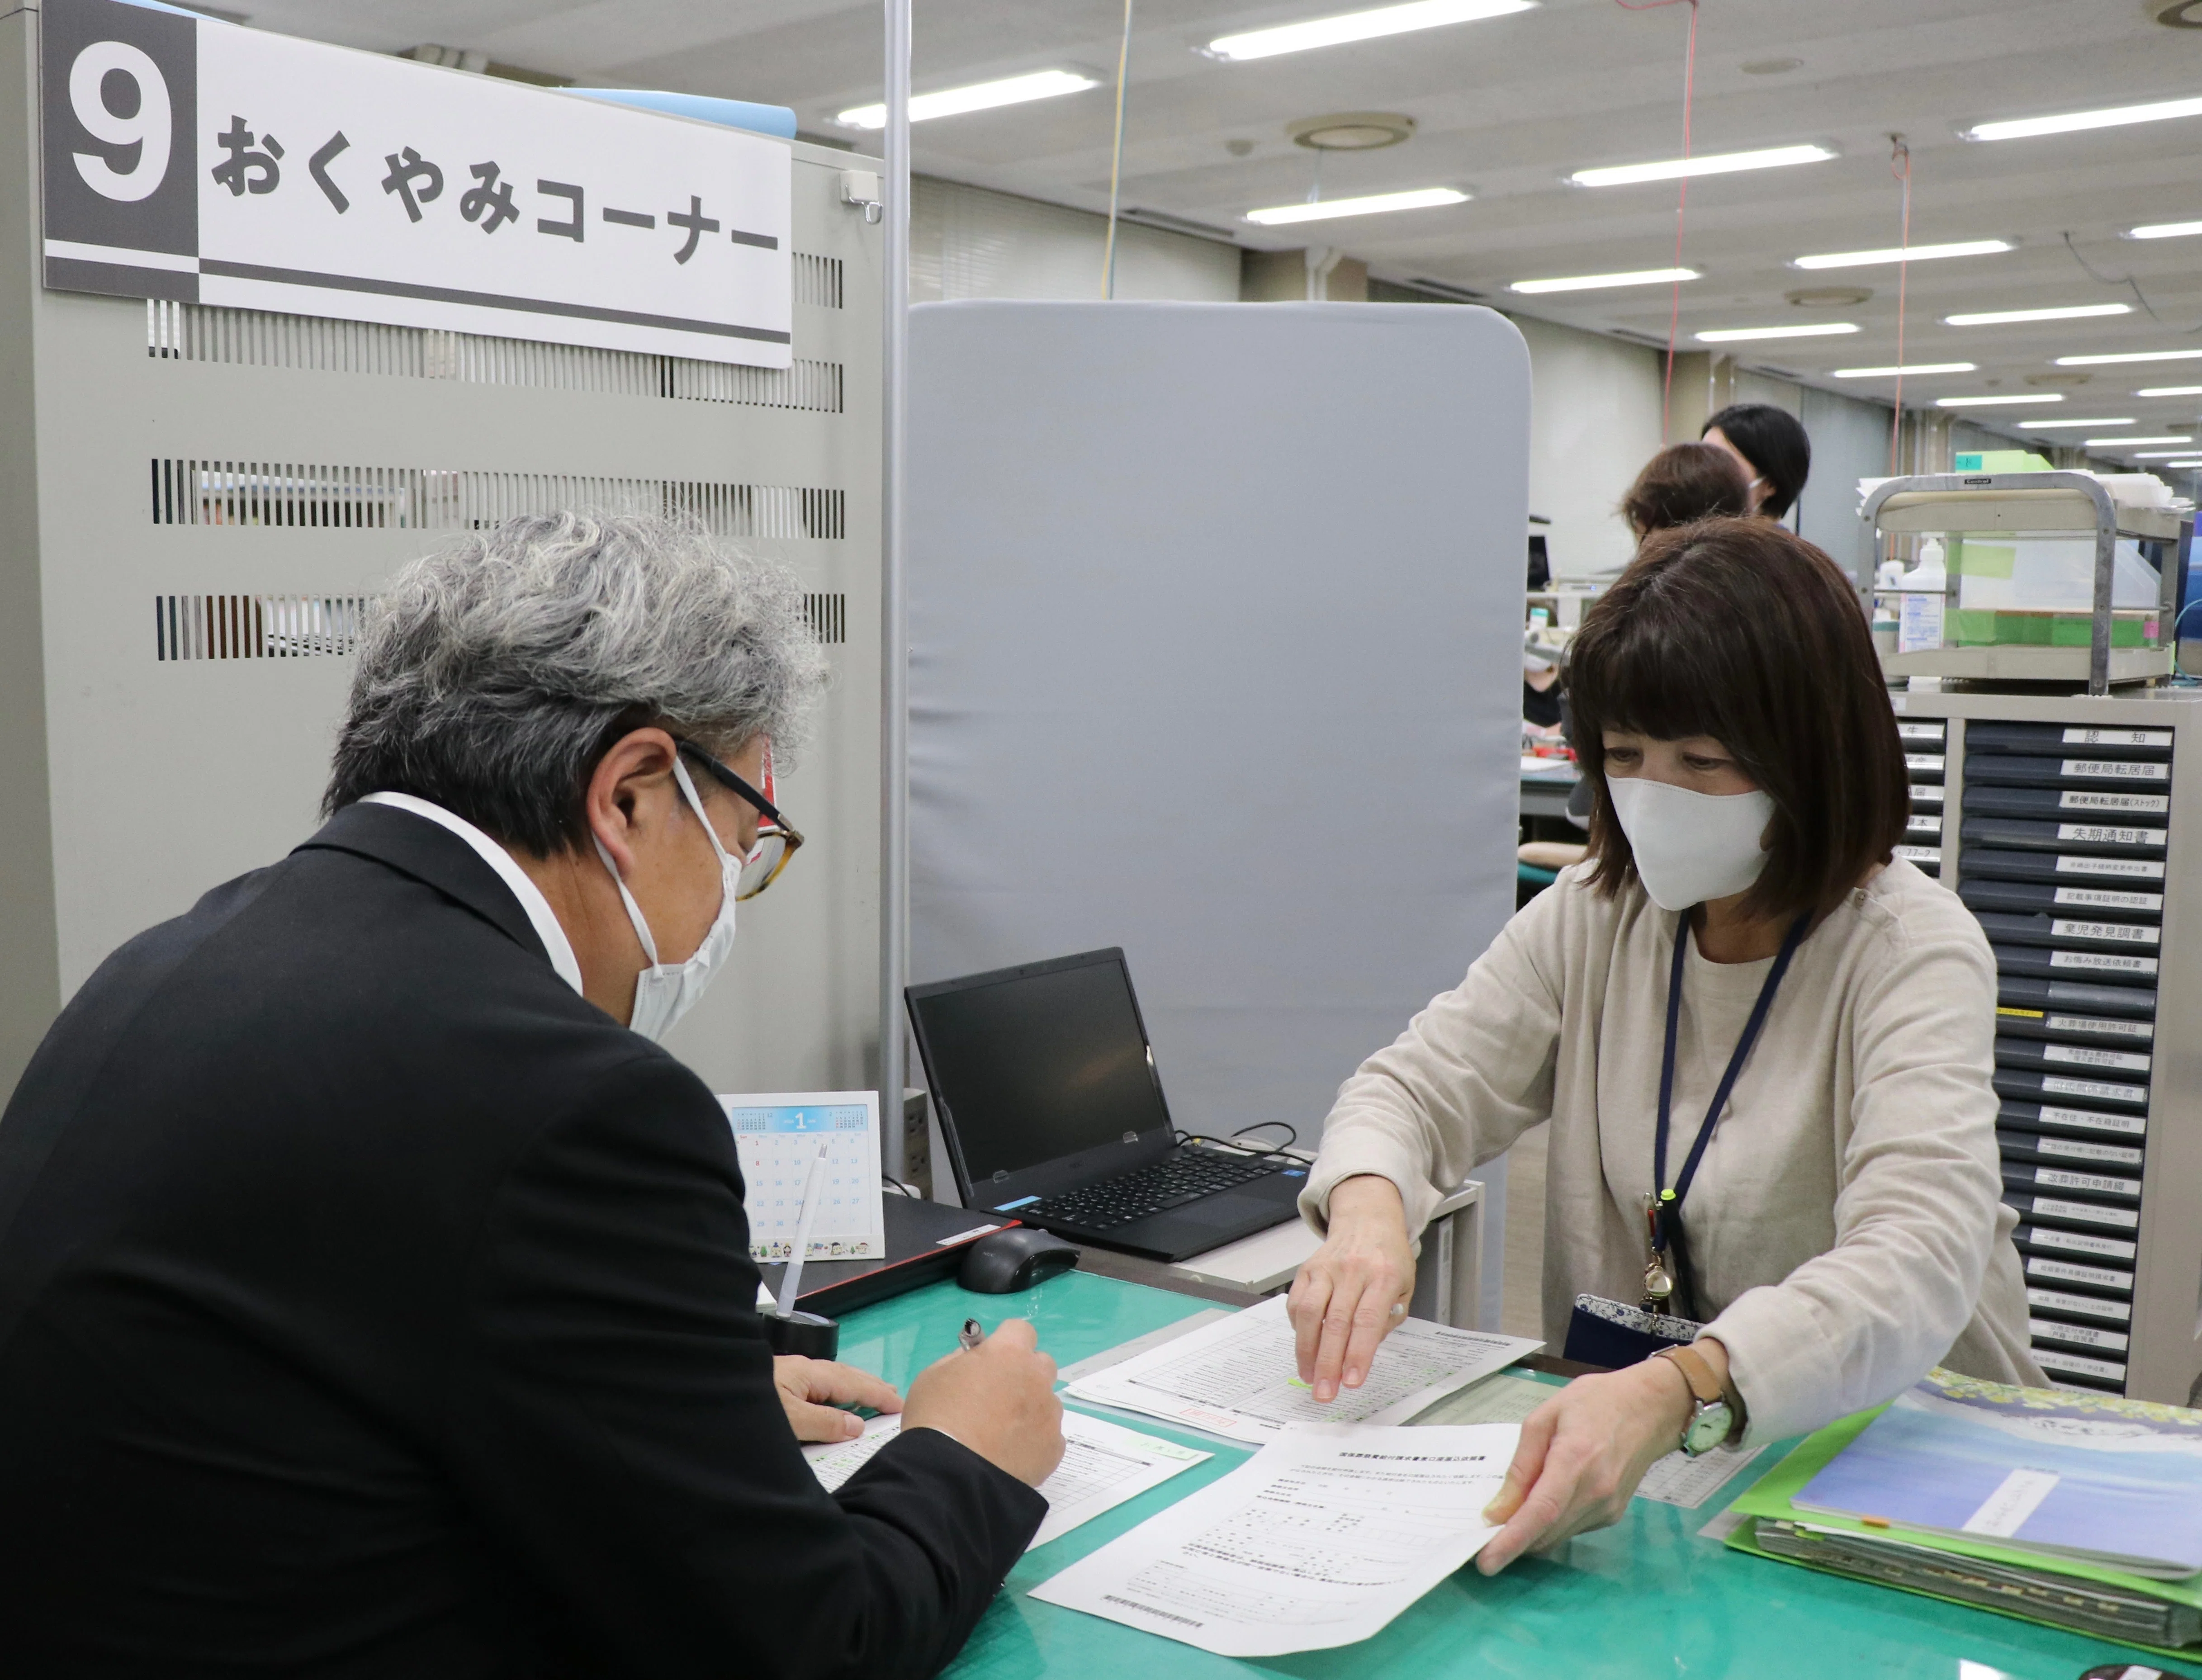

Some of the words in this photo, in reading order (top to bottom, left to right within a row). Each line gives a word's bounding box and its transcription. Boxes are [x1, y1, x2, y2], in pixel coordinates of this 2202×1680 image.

[69, 40, 172, 202] 9
[211, 115, 778, 265] おくやみコーナー
[2084, 729, 2099, 744] 認
[2131, 732, 2145, 743] 知
[2074, 763, 2155, 776] 郵便局転居届
[2073, 828, 2149, 844] 失期通知書
[2064, 923, 2144, 939] 棄児発見調書
[2064, 955, 2142, 968] お悔み放送依頼書
[795, 1112, 807, 1129] 1
